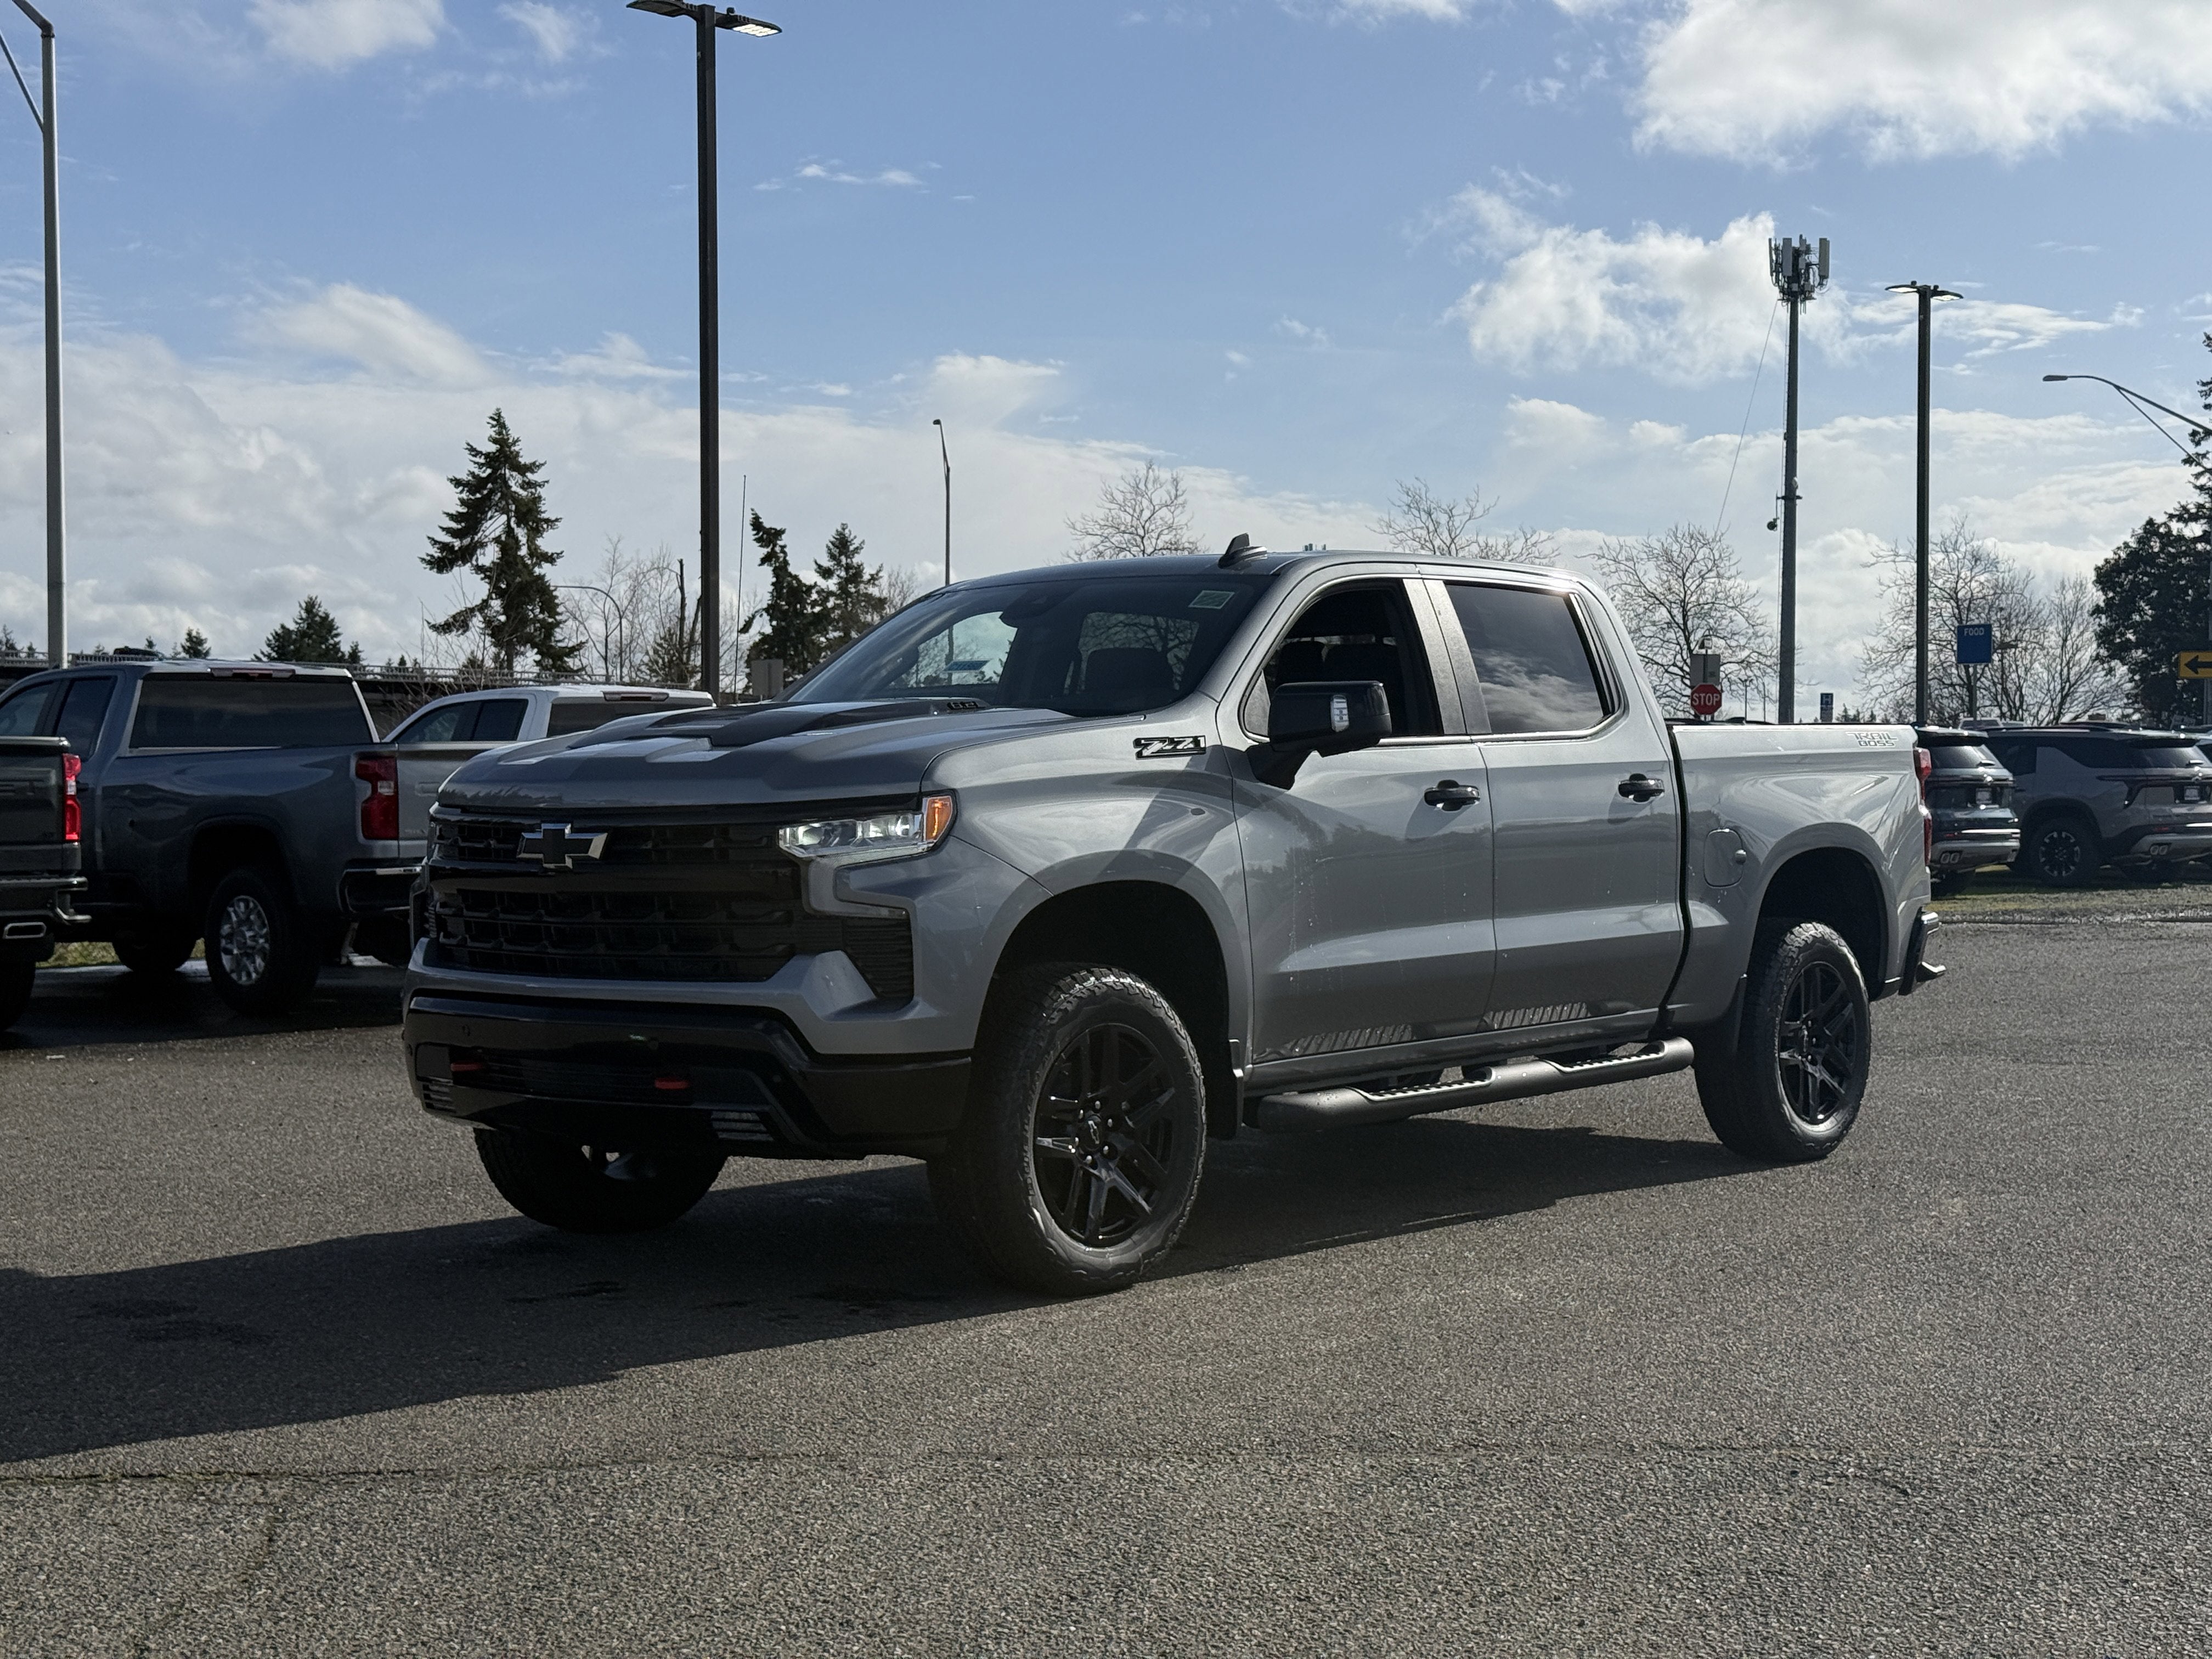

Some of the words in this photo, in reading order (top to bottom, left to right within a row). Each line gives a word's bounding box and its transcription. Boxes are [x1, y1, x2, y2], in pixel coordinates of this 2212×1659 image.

[1964, 627, 1984, 636] FOOD
[1692, 693, 1720, 706] STOP
[1822, 694, 1832, 704] H
[1846, 732, 1898, 740] TRAIL
[1133, 735, 1206, 760] Z71
